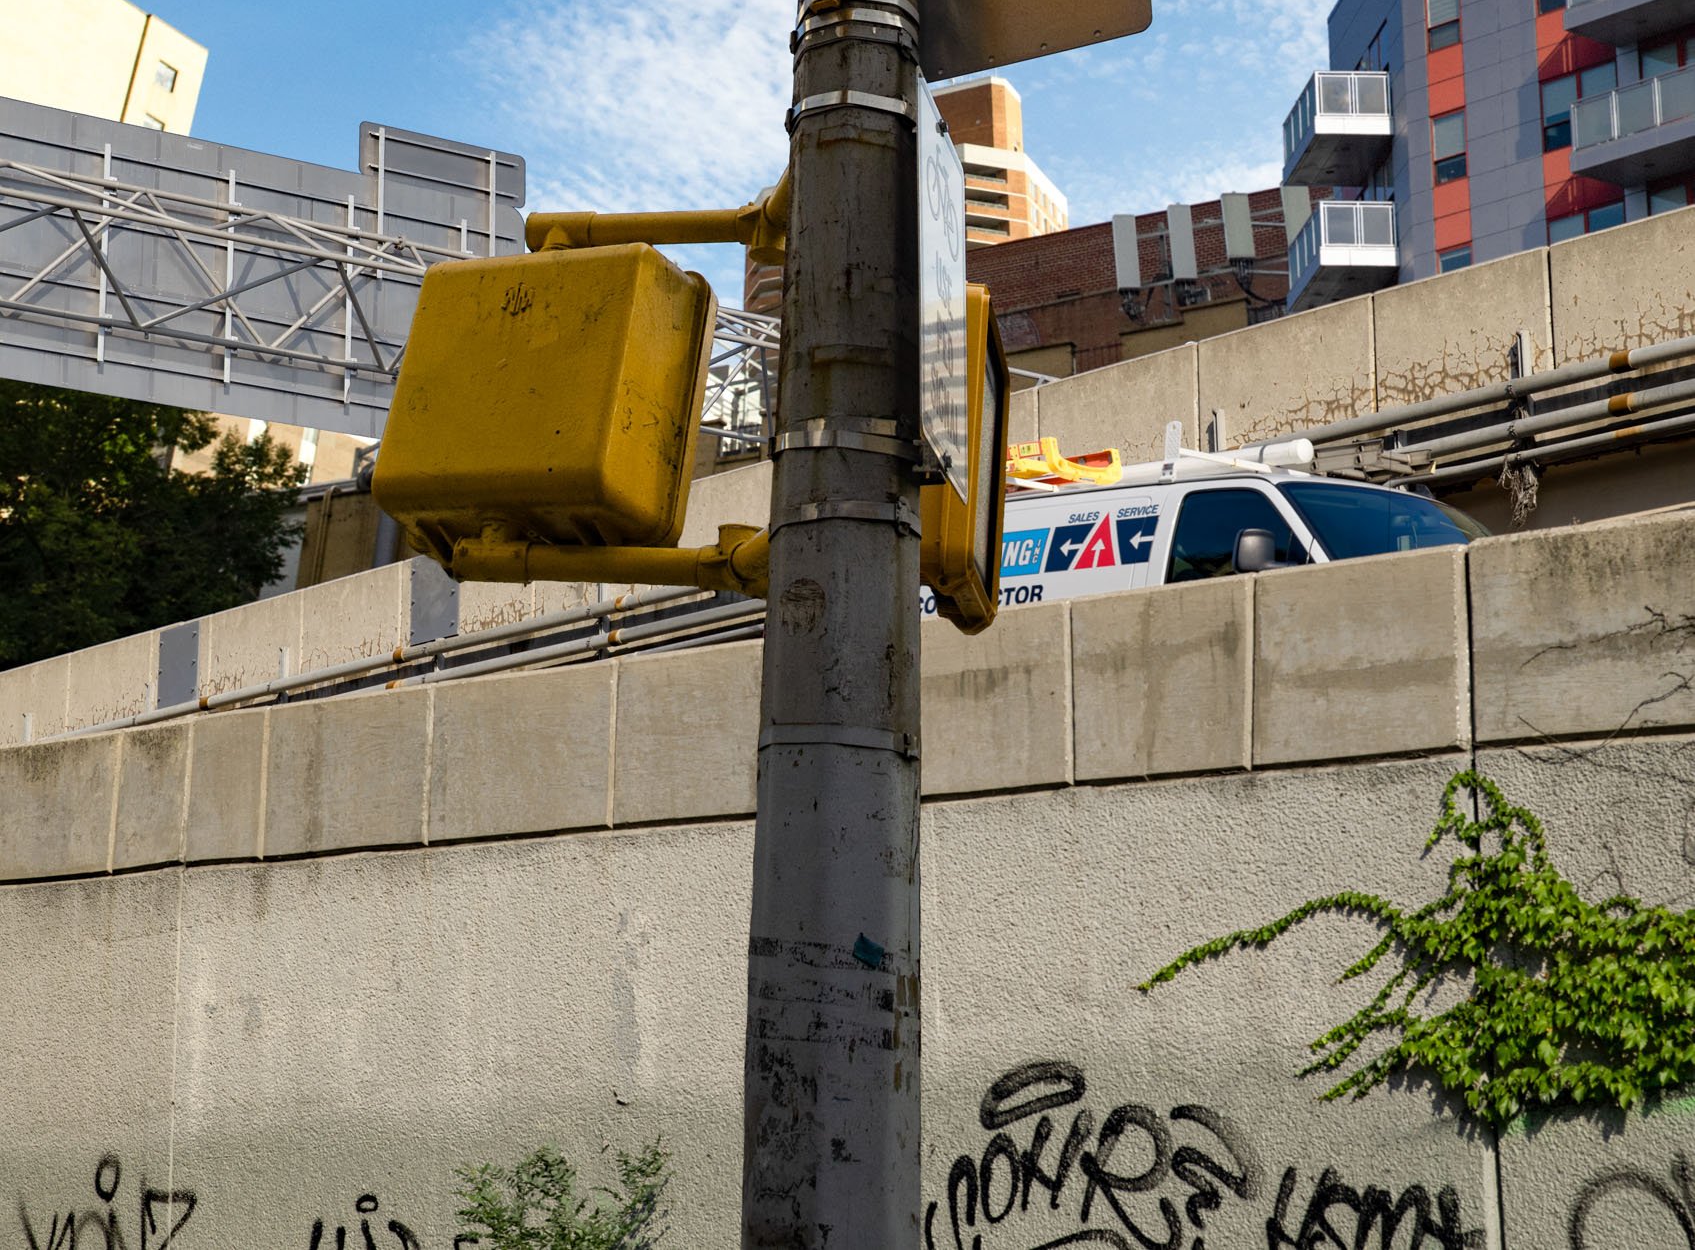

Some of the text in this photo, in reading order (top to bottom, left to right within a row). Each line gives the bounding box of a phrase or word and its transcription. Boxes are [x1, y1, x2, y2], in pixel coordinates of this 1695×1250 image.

[1068, 504, 1159, 524] SALES SERVICE
[1001, 538, 1034, 568] ING
